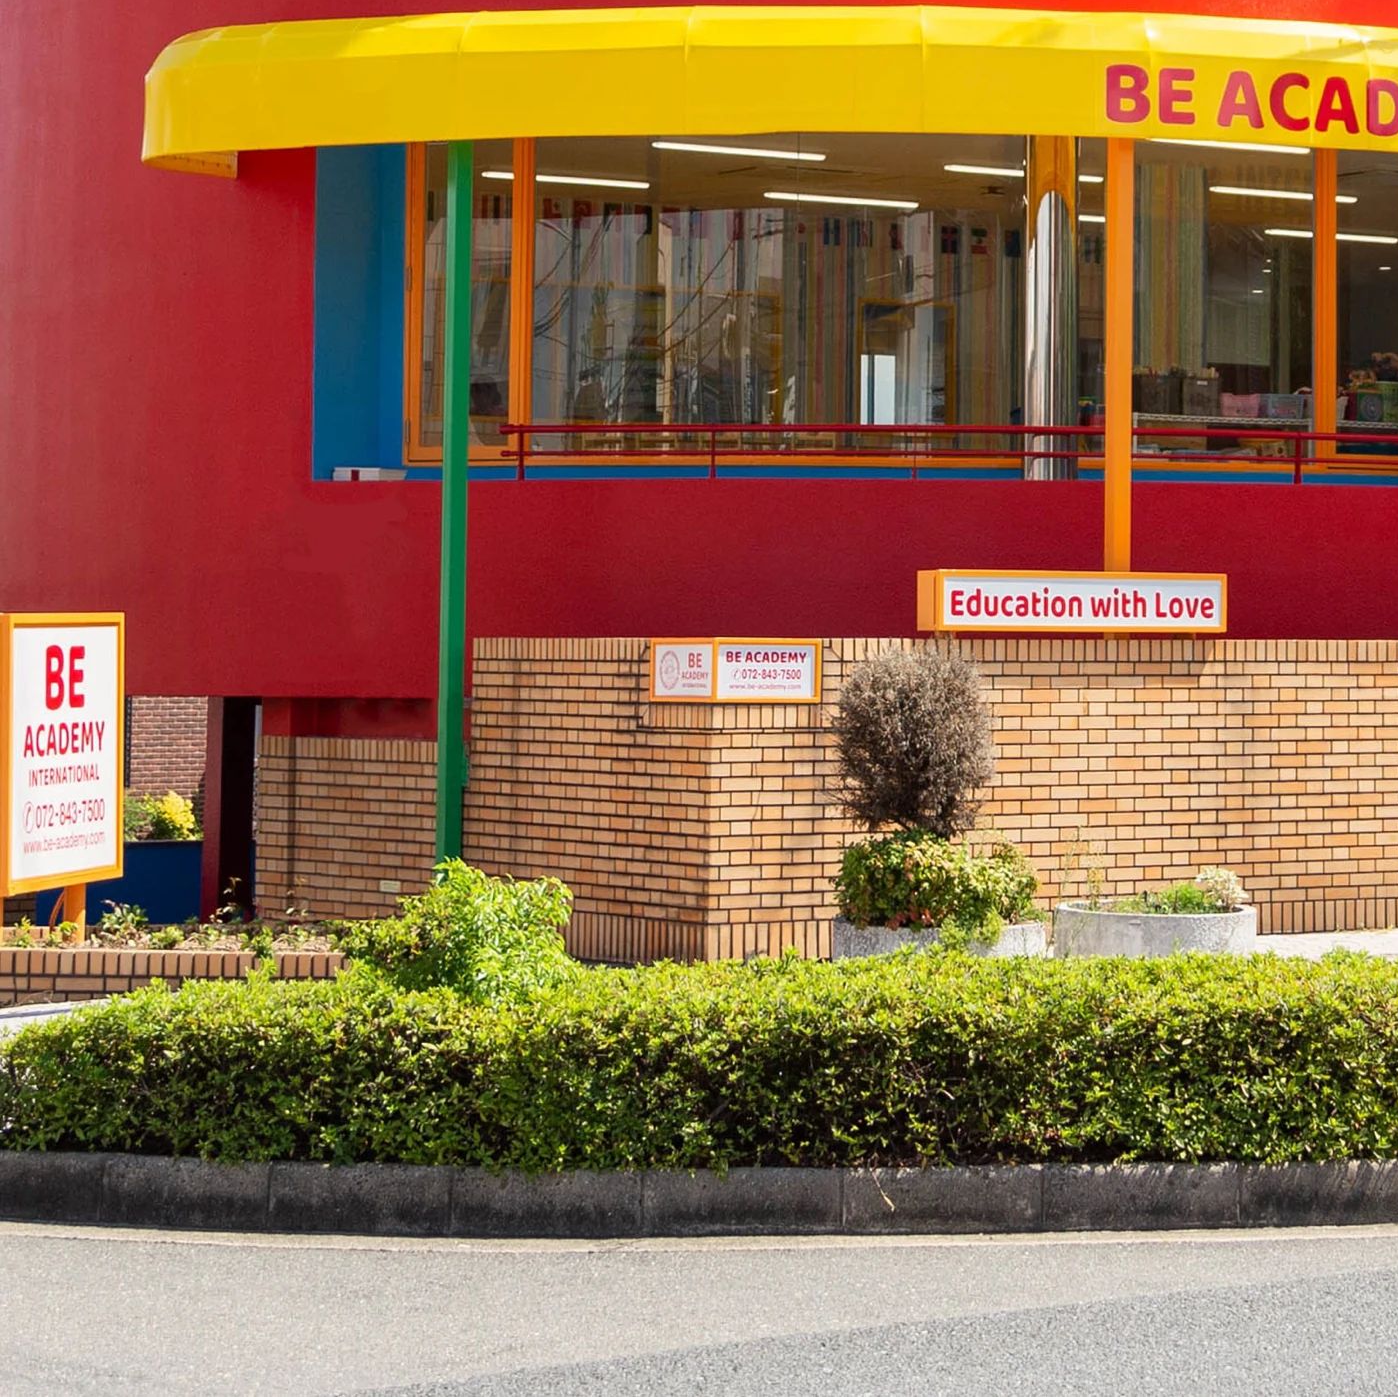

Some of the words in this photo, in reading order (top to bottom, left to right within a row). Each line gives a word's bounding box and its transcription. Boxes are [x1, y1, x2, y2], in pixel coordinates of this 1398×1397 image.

[1106, 63, 1196, 125] BE
[951, 588, 1083, 618] Education
[1090, 589, 1148, 618] with
[1155, 592, 1215, 619] Love
[688, 652, 703, 669] BE
[725, 650, 742, 664] BE
[745, 650, 808, 664] ACADEMY
[44, 644, 86, 711] BE
[681, 670, 708, 680] ACADEMY
[742, 668, 801, 680] 072-843-7500
[23, 719, 106, 758] ACADEMY
[28, 763, 100, 787] INTERNATIONAL
[35, 798, 105, 828] 072-843-7500
[23, 832, 105, 854] www.be-academy.com
